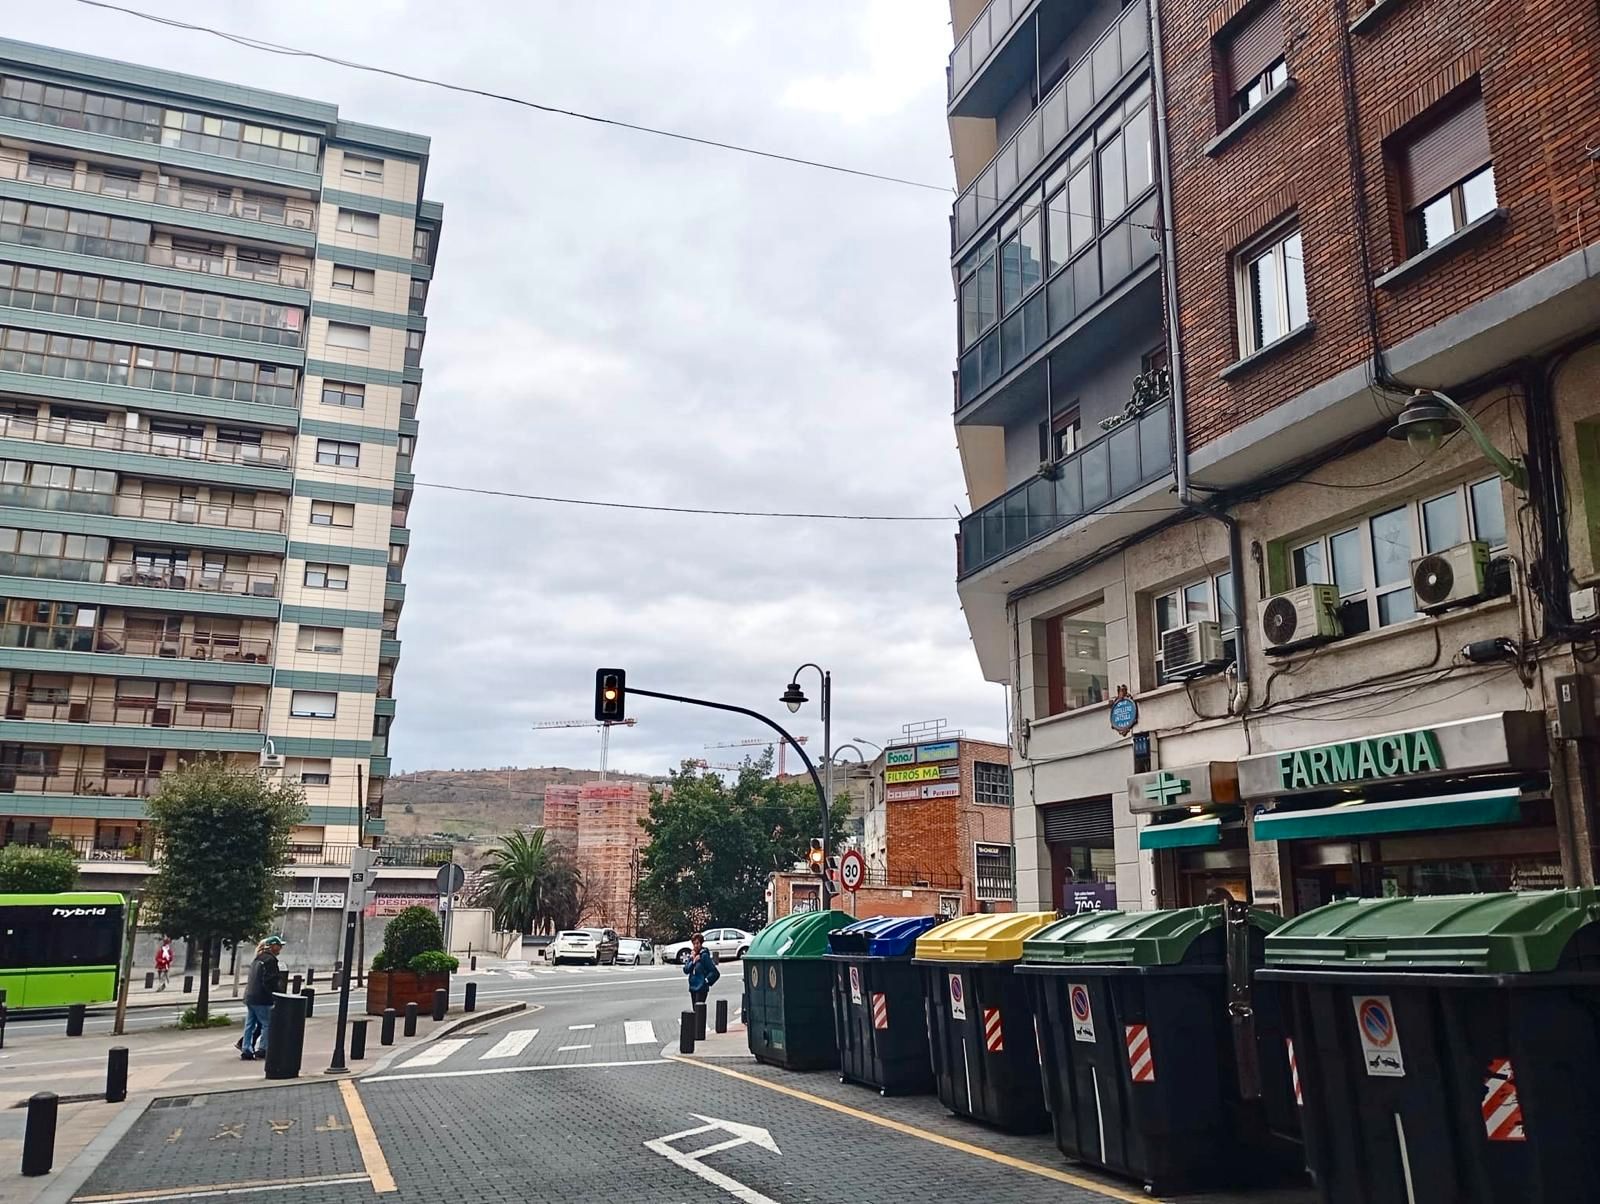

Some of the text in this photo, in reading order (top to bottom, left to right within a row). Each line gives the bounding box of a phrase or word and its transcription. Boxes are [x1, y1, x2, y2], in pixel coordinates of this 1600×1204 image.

[1278, 730, 1438, 790] FARMACIA
[887, 770, 920, 782] FILTROS
[922, 767, 939, 779] MA
[844, 864, 859, 878] 30
[52, 907, 107, 918] hybrid
